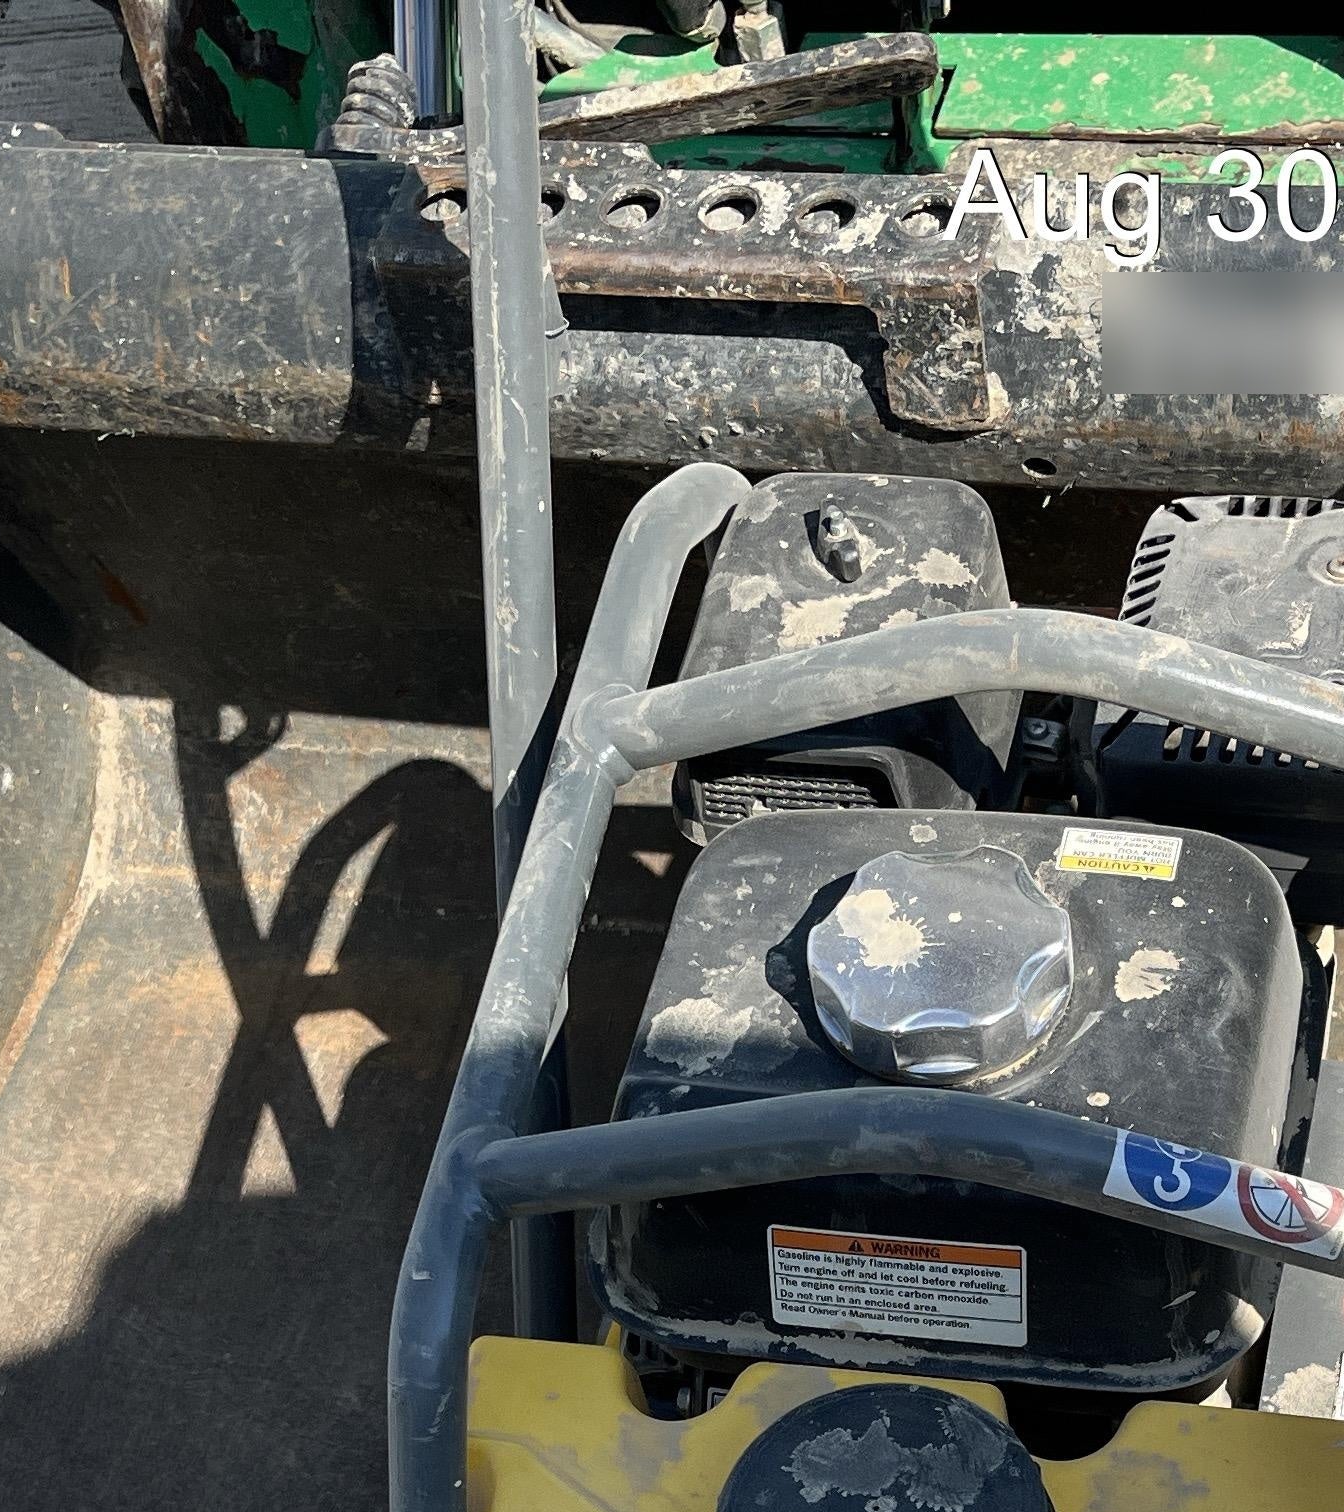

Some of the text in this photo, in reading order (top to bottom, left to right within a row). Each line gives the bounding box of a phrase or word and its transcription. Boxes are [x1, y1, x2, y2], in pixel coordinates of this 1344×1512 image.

[1077, 859, 1140, 872] CAUTION
[871, 1241, 941, 1258] WARNING
[777, 1249, 1004, 1278] Gasoline is highly flammable and explosive.
[778, 1262, 1009, 1292] Turn engine off and let cool before refueling.
[779, 1277, 991, 1304] The engine emits toxic carbon monoxide.
[780, 1289, 794, 1298] Do
[797, 1292, 813, 1300] not
[836, 1295, 845, 1303] in
[864, 1299, 910, 1309] enclosed
[913, 1304, 940, 1312] area.
[781, 1303, 972, 1329] Read Owner's Manual before operation.
